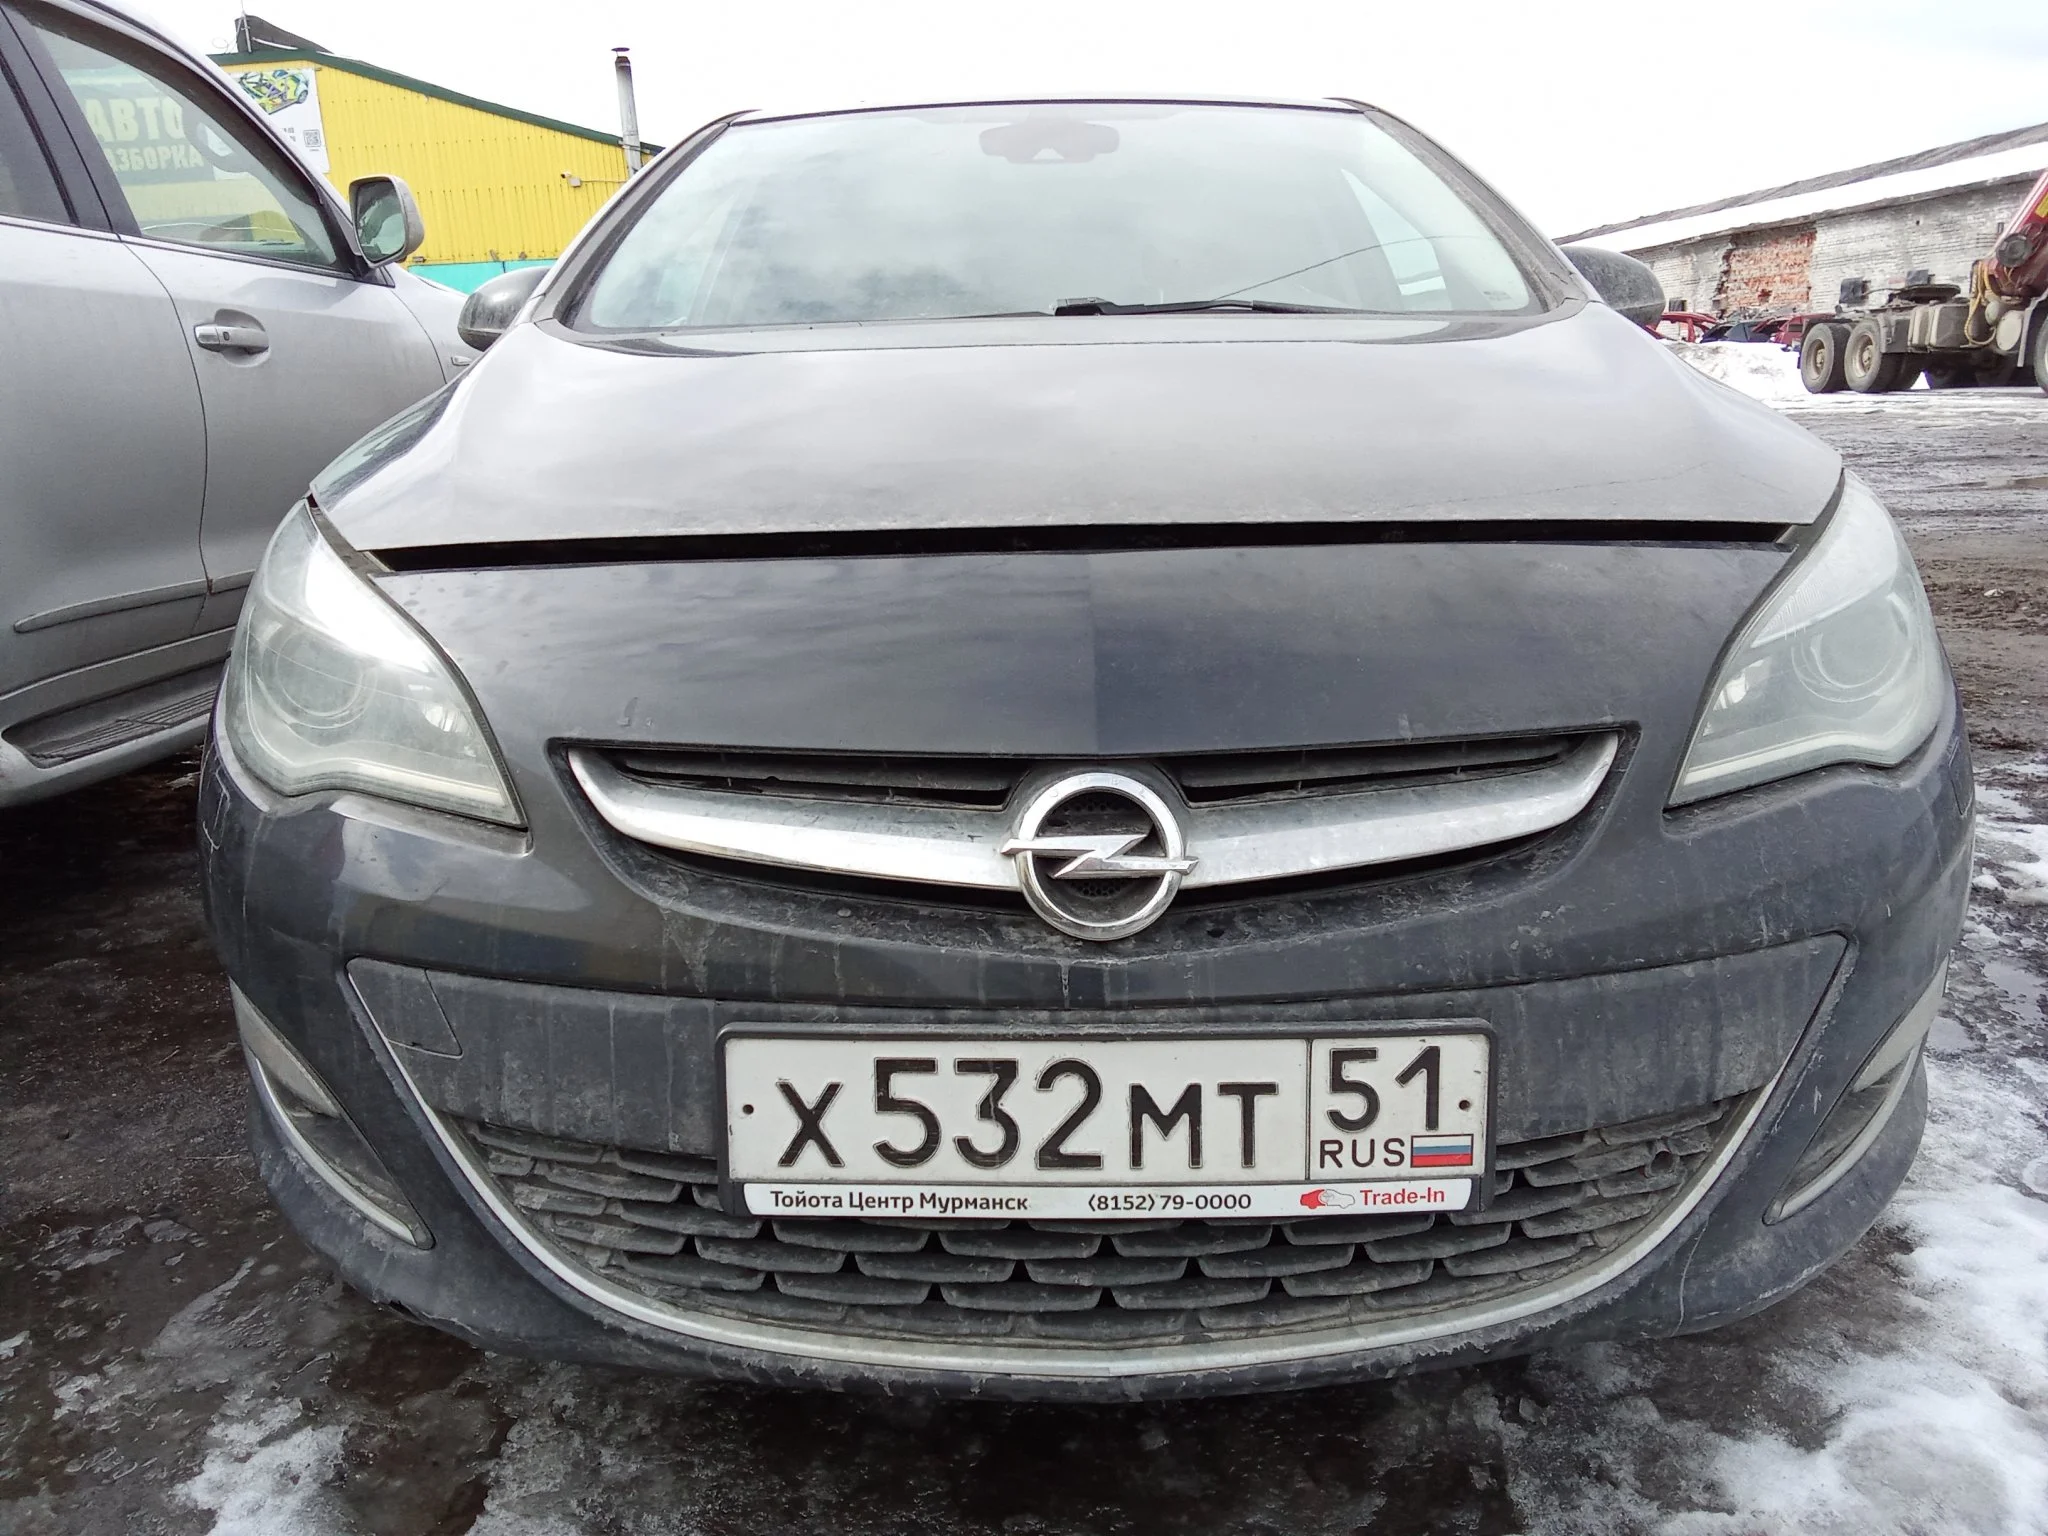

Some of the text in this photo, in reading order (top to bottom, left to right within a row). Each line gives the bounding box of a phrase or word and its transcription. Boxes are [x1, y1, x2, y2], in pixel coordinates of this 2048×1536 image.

[84, 97, 186, 142] АВТО
[1049, 776, 1148, 799] OPEL
[1326, 1045, 1441, 1133] 51
[1319, 1137, 1405, 1169] RUS
[770, 1190, 843, 1209] Тойота
[849, 1191, 914, 1212] Центр
[919, 1191, 1029, 1214] Мурманск
[1360, 1187, 1445, 1206] Trade-In
